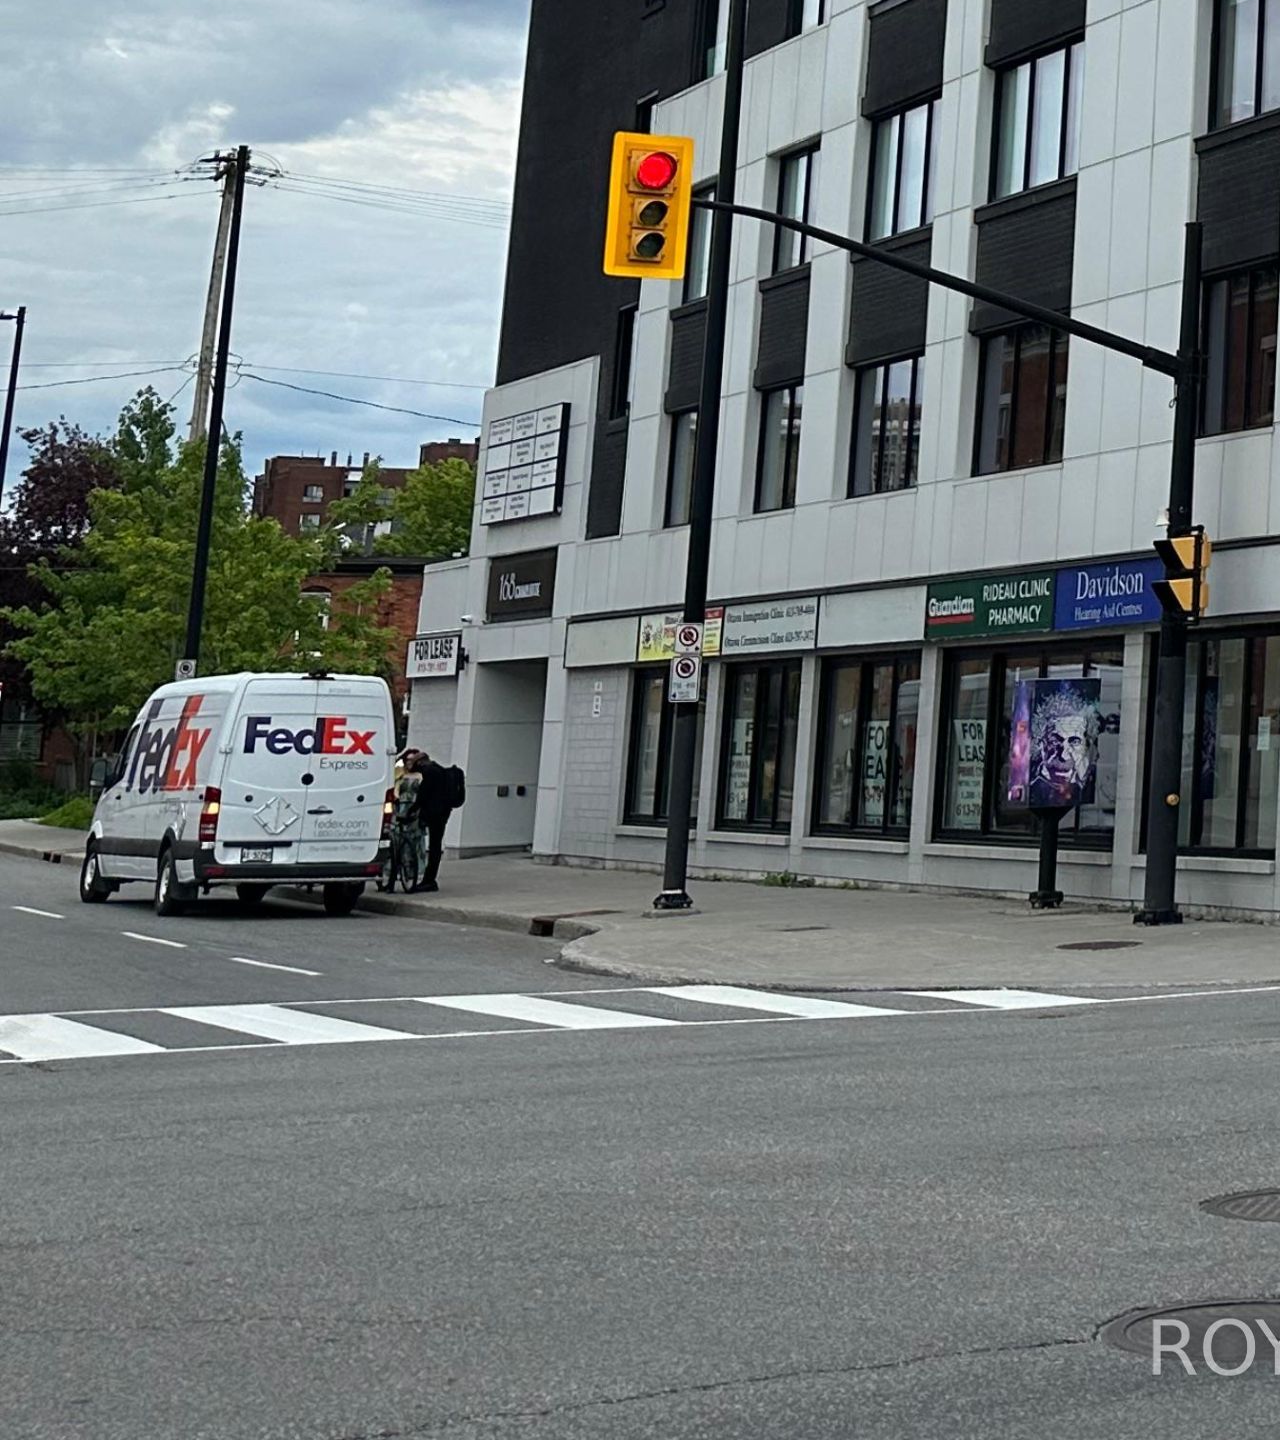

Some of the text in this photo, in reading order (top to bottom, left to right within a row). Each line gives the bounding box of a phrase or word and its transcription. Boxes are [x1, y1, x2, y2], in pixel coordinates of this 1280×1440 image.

[983, 577, 1051, 602] RIDEAU CLINIC
[1076, 565, 1143, 600] Davidson
[928, 595, 974, 617] Guardian
[988, 604, 1042, 626] PHARMACY
[1074, 602, 1143, 623] Hearing Aid Centres
[415, 638, 453, 661] FOR LEASE
[243, 716, 377, 755] FedEx
[961, 723, 984, 740] FOR
[125, 694, 212, 795] FedEx
[959, 745, 985, 763] LEAS
[319, 757, 369, 771] Express
[314, 818, 370, 829] fedex.com
